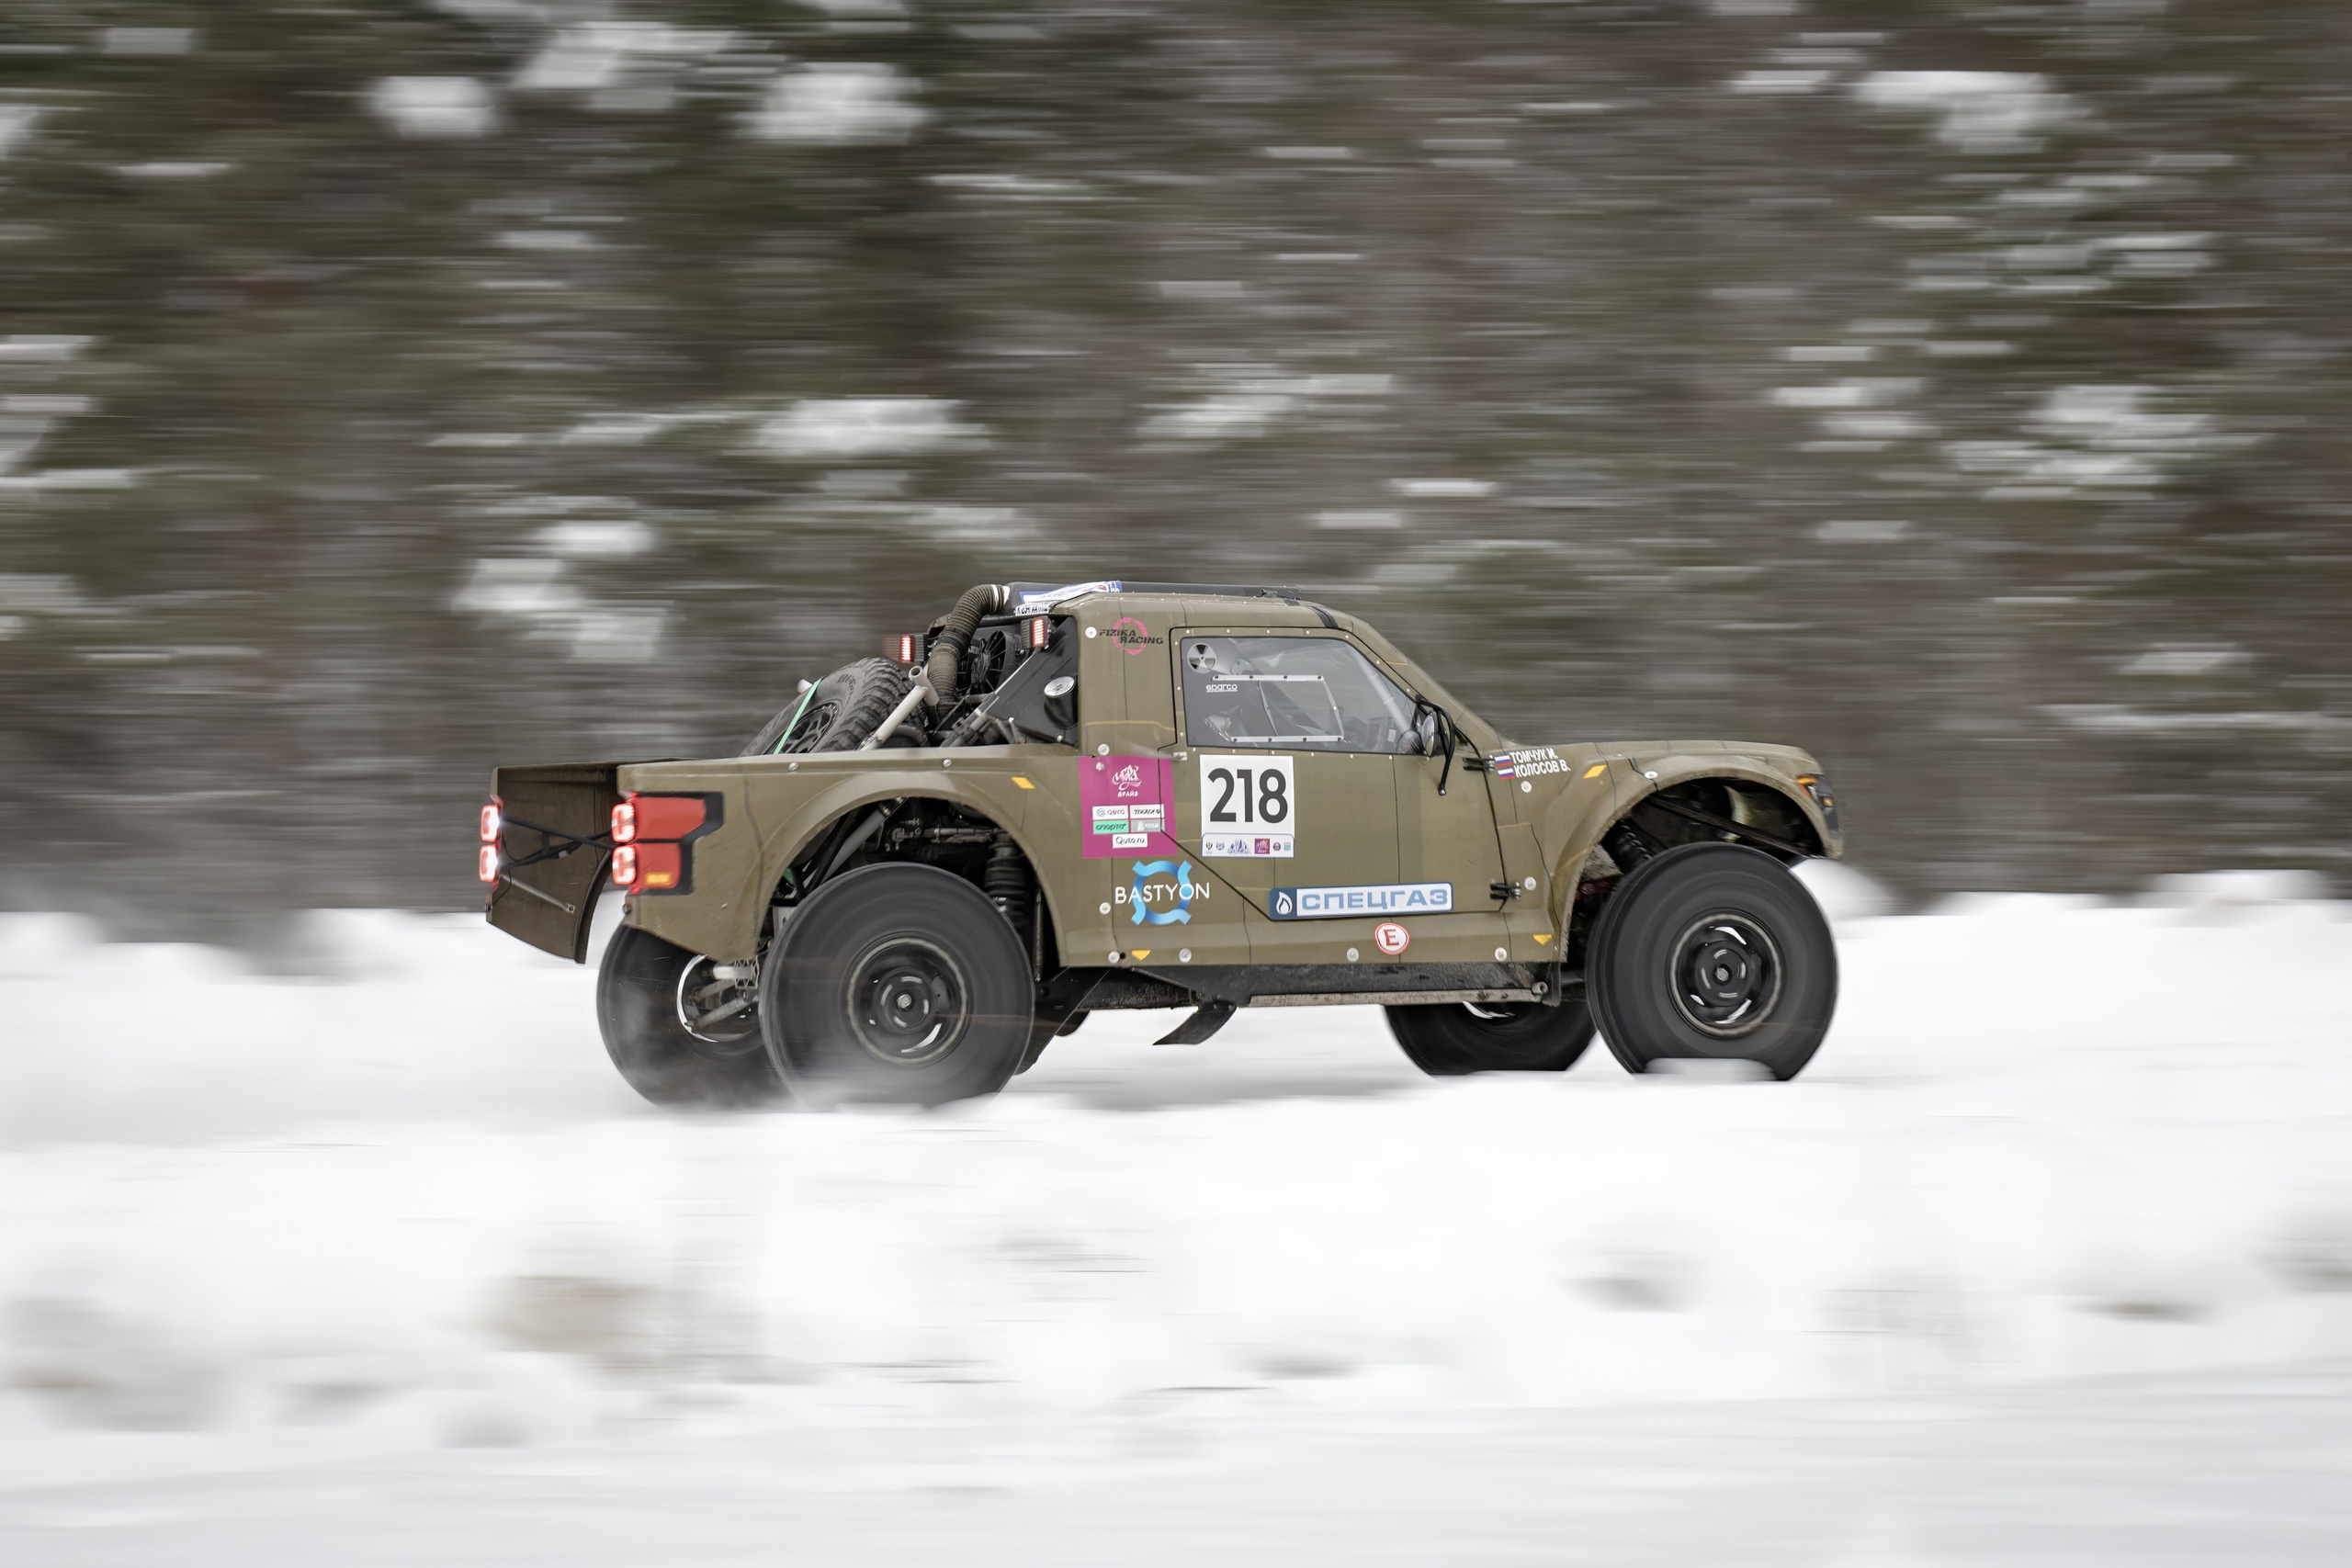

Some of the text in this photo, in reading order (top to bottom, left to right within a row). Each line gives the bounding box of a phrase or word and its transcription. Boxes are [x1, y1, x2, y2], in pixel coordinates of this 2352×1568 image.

[1509, 749, 1548, 764] ТОМЧУК
[1513, 760, 1560, 778] КОЛОСОВ
[1207, 768, 1288, 824] 218
[1114, 882, 1209, 904] BASTYON
[1302, 888, 1448, 910] СПЕЦГАЗ
[1383, 929, 1400, 947] E
